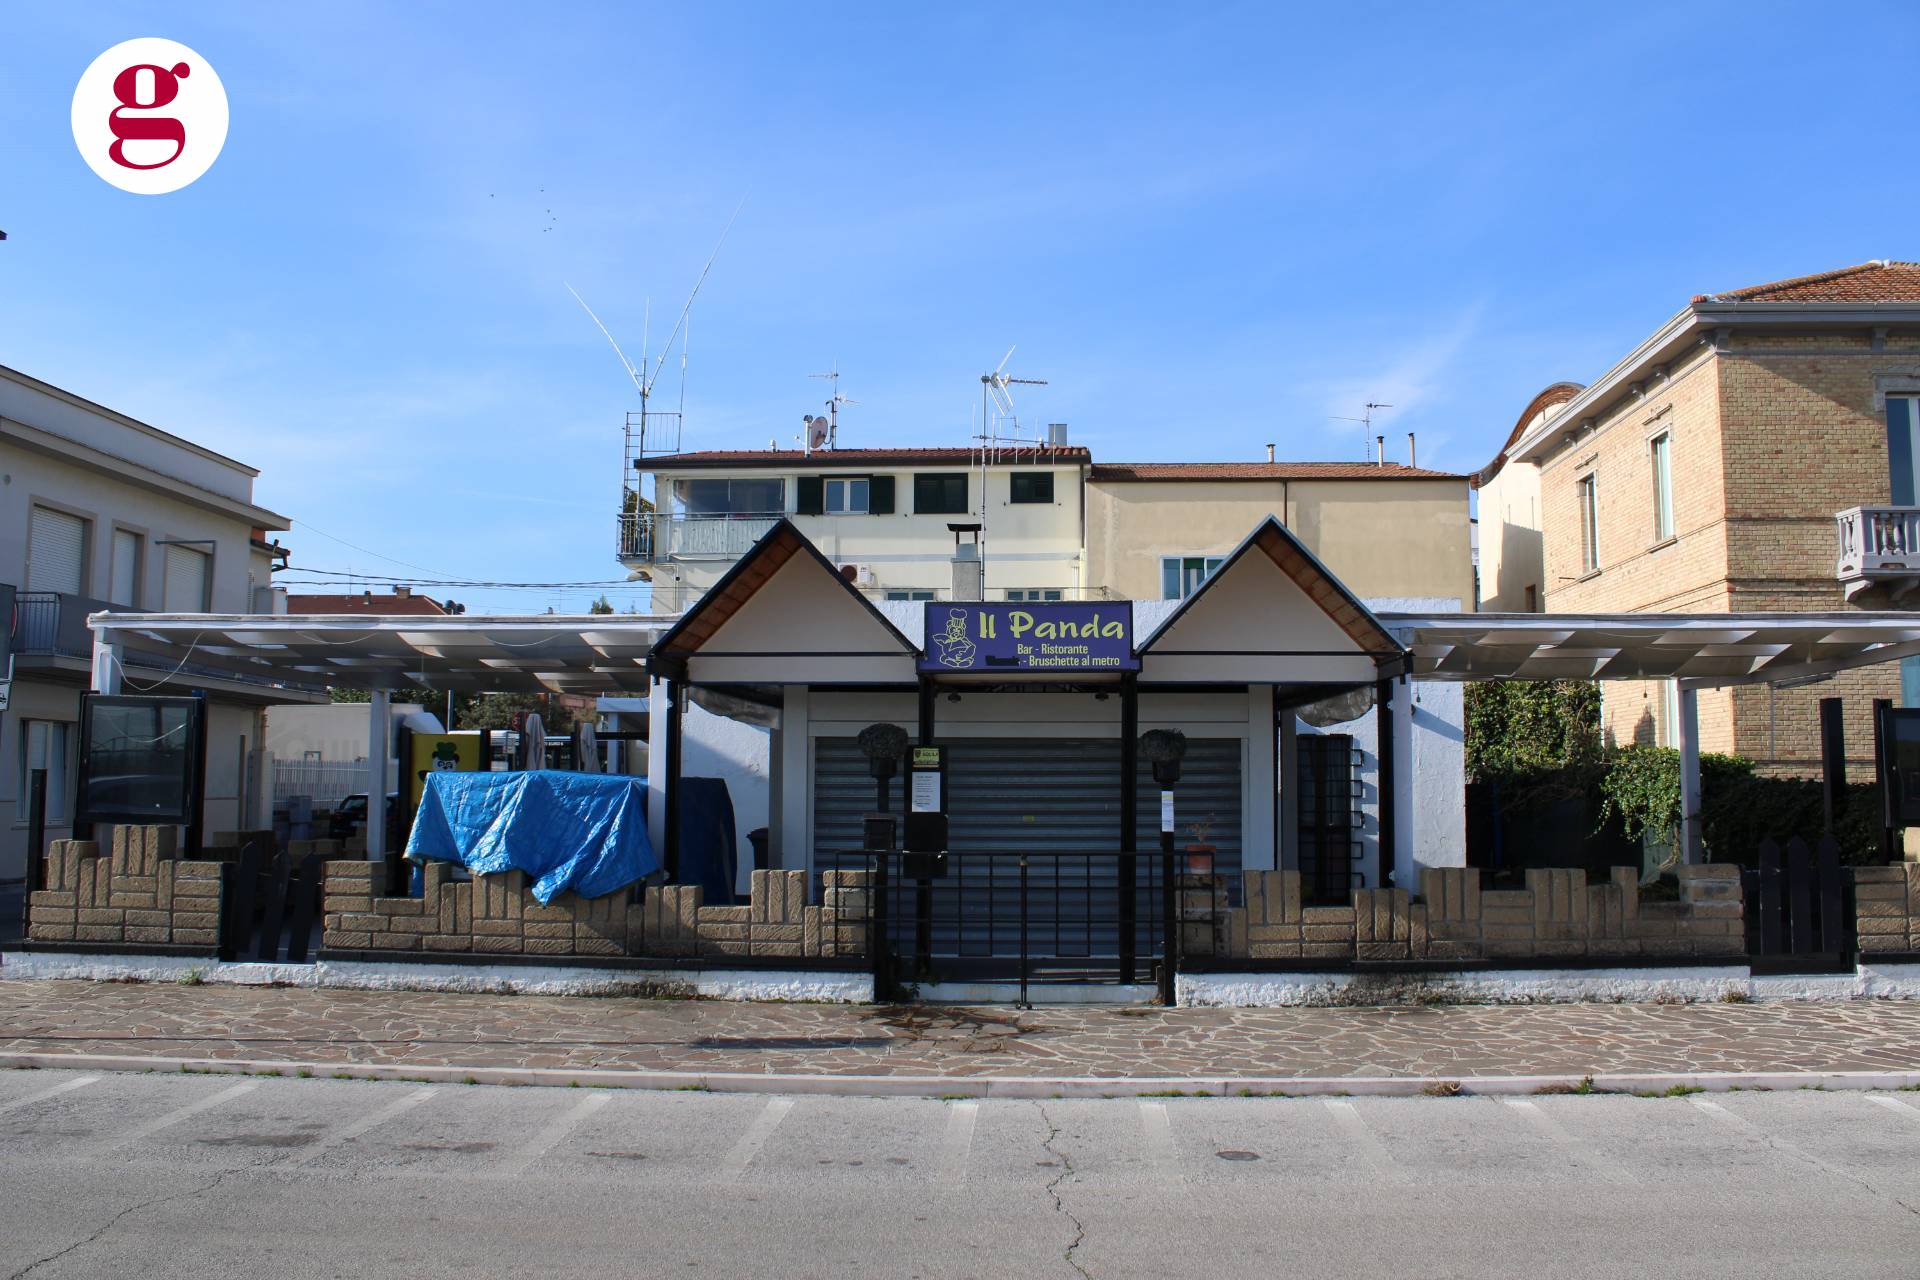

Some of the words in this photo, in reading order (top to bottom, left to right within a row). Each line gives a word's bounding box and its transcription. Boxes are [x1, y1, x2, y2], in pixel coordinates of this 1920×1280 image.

[979, 611, 996, 639] Il
[1008, 611, 1124, 640] Panda
[1017, 643, 1032, 654] Bar
[1041, 643, 1088, 654] Ristorante
[1029, 655, 1080, 667] Bruschette
[1081, 655, 1090, 666] al
[1092, 656, 1120, 666] metro
